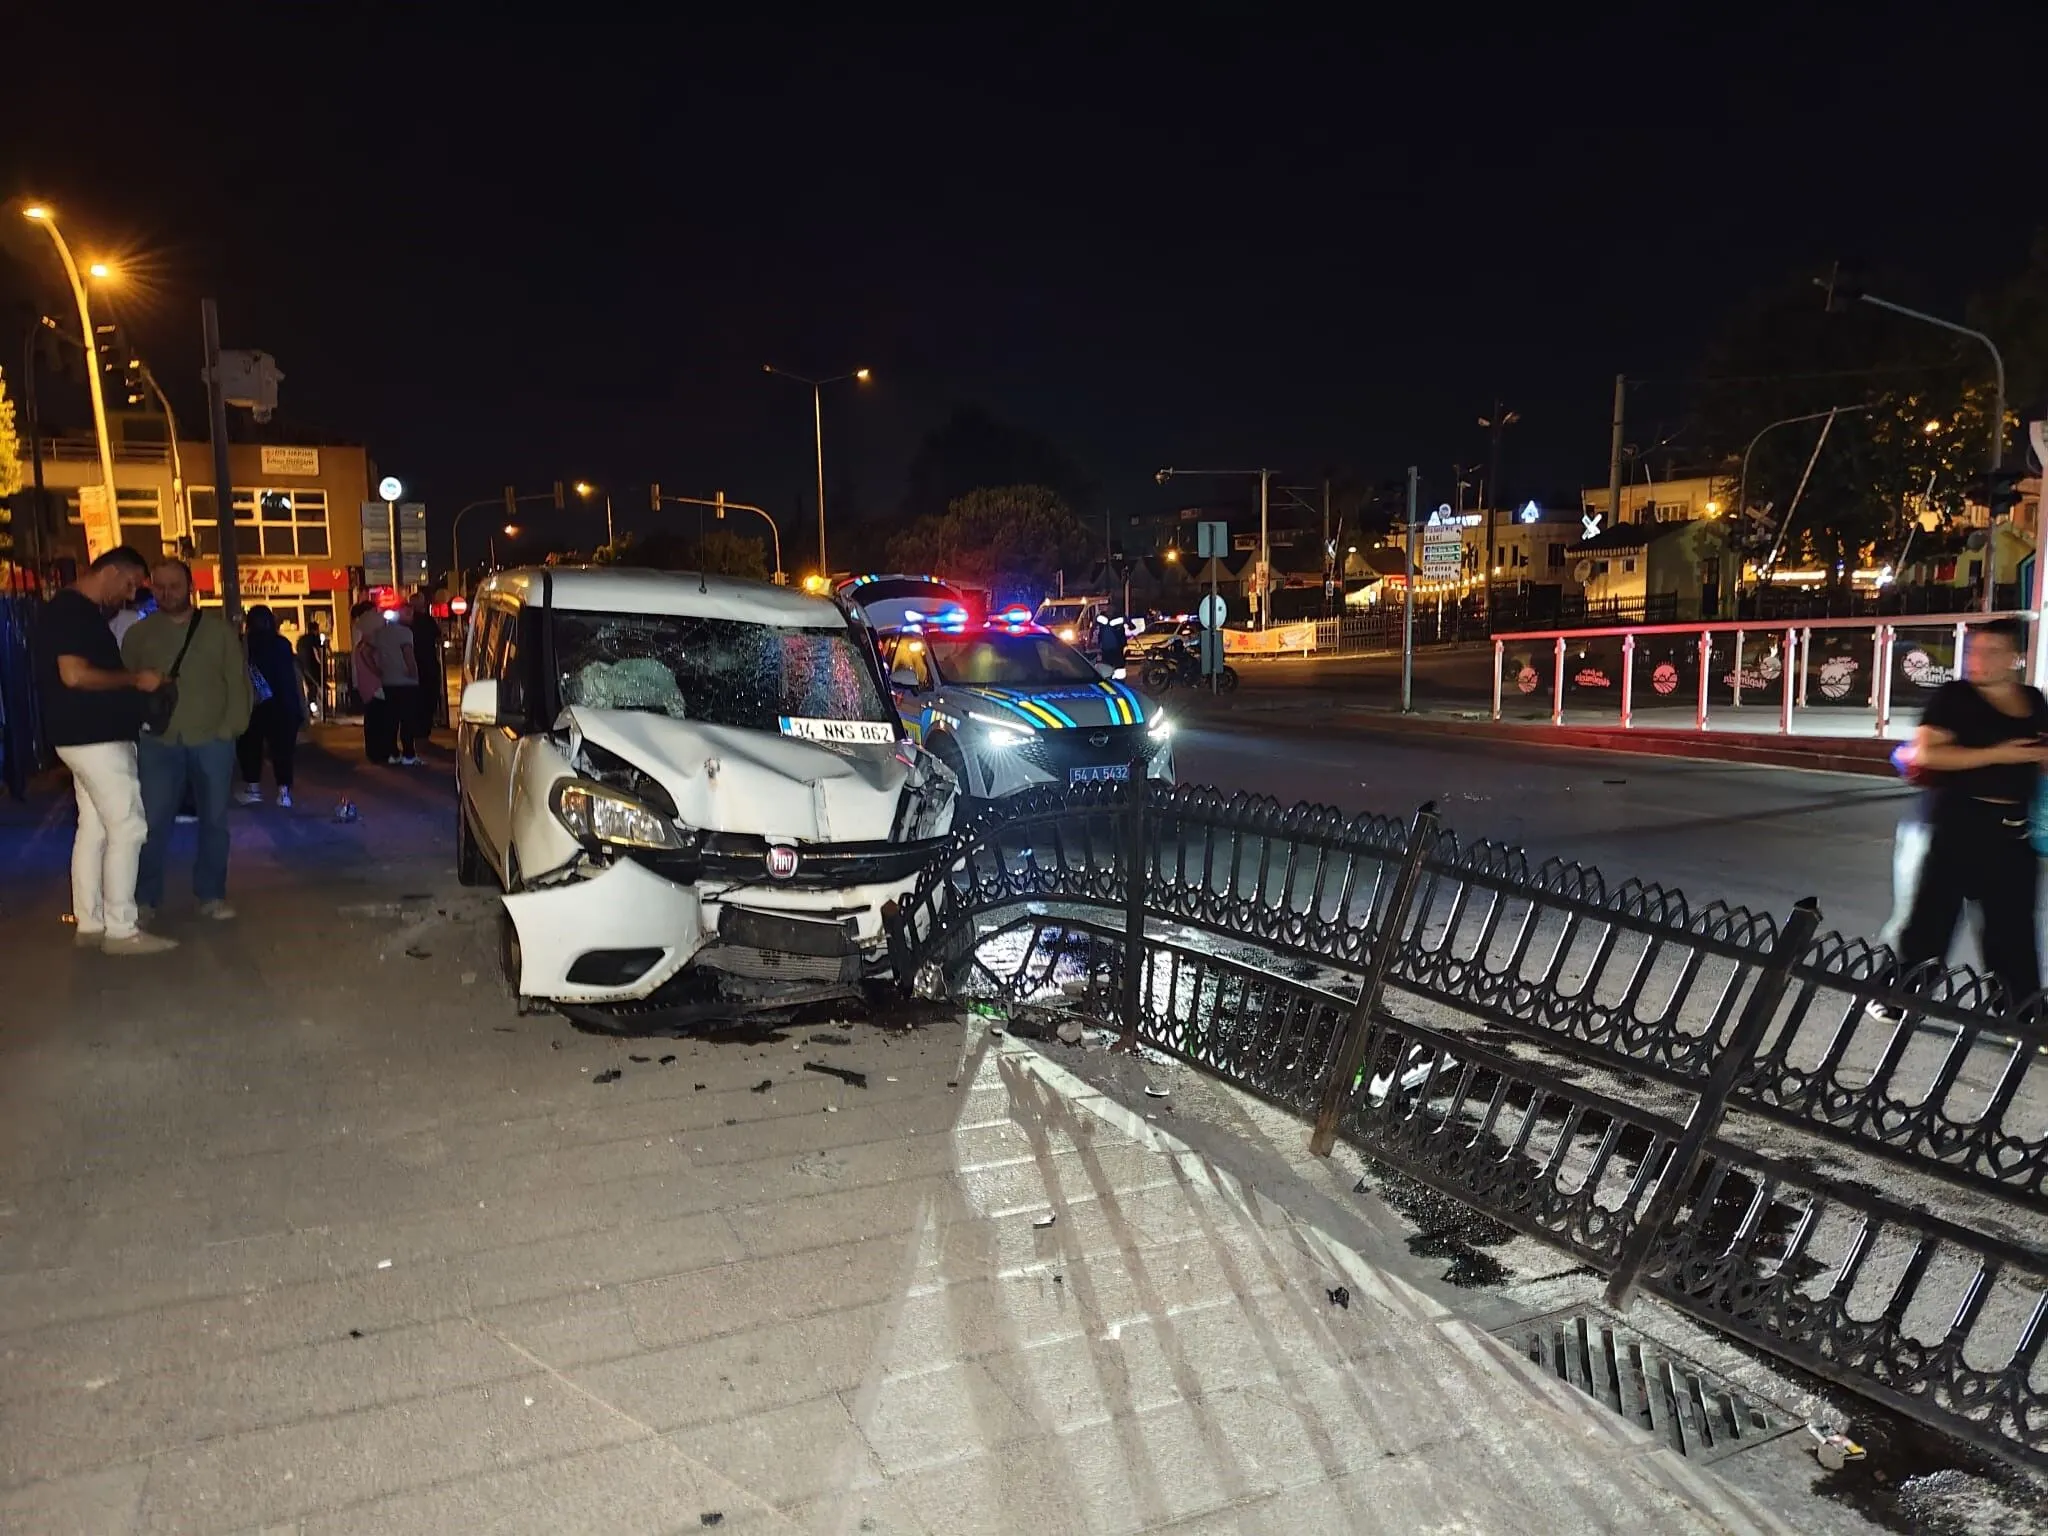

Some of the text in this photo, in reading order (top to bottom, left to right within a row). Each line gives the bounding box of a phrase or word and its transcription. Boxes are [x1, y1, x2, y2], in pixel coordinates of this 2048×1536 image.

[794, 721, 815, 739] 34
[823, 723, 856, 740] NNS
[860, 725, 892, 743] 862
[1091, 768, 1099, 780] A
[1103, 767, 1128, 780] 5432
[773, 853, 793, 871] FIAT
